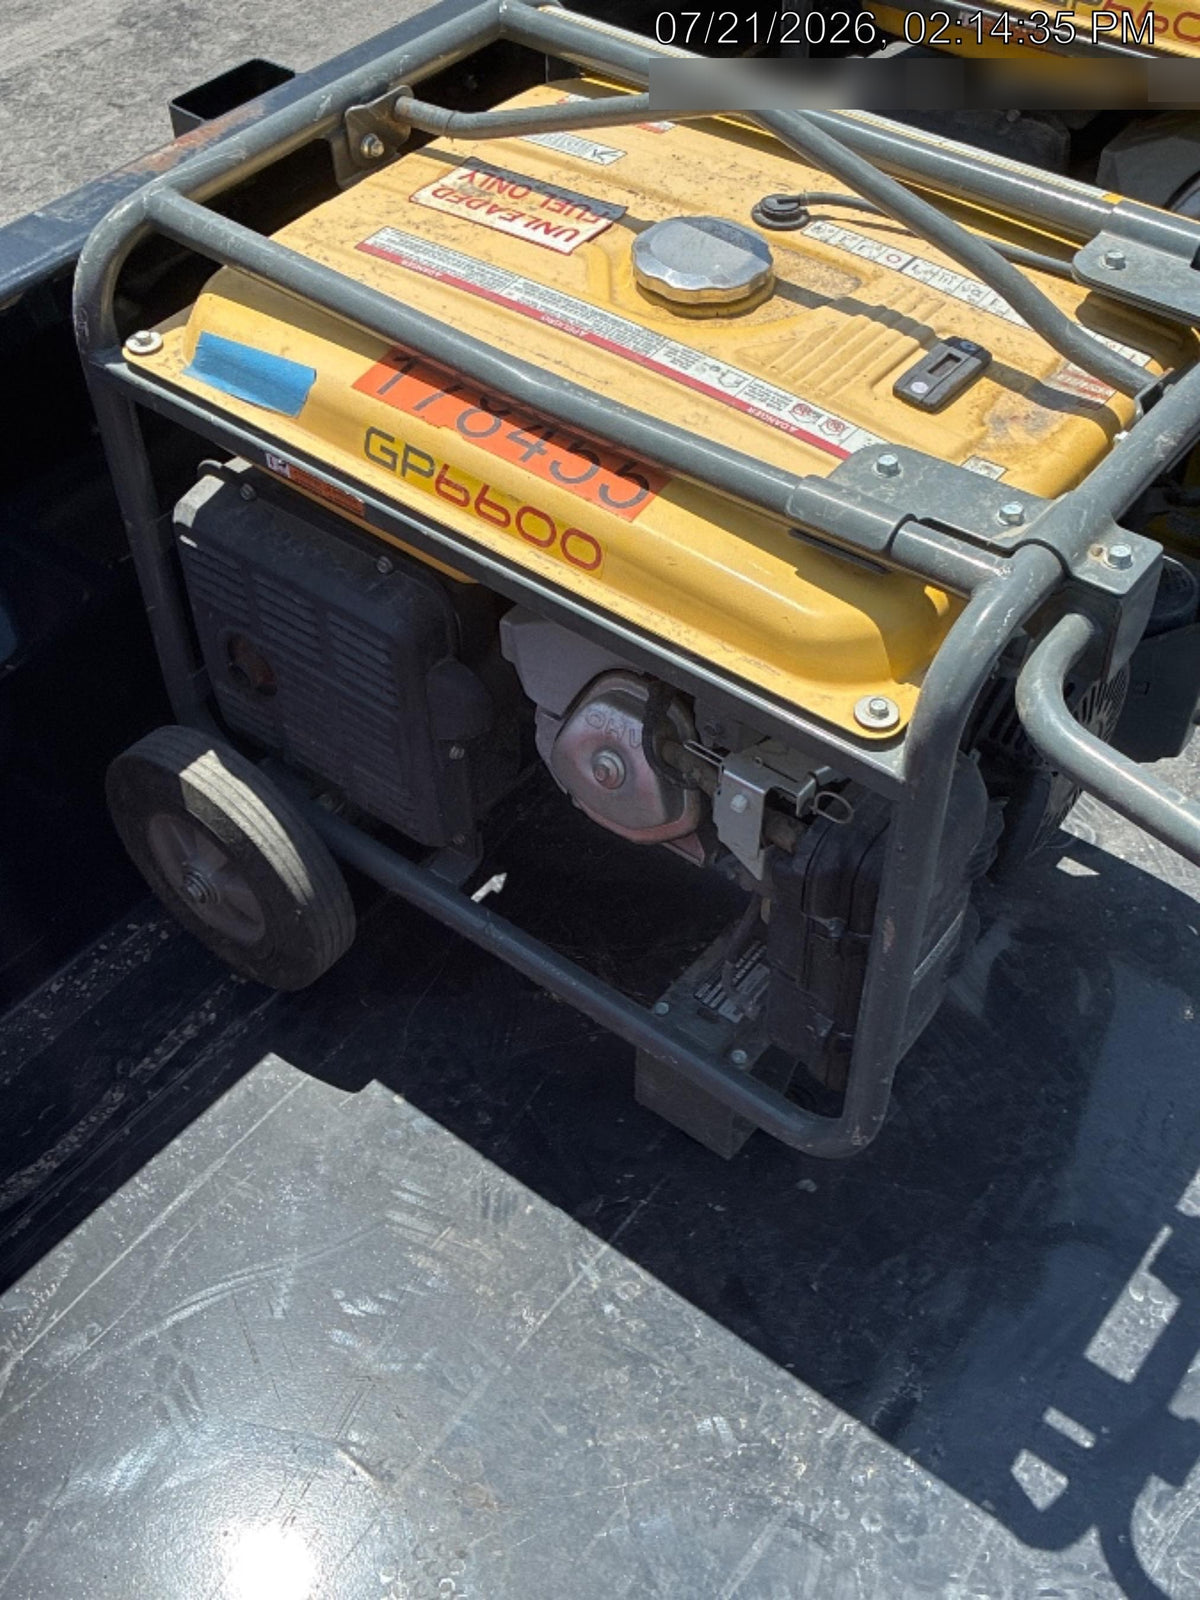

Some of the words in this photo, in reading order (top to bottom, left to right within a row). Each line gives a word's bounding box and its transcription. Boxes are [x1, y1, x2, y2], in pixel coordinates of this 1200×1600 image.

[459, 169, 532, 199] ONLY
[431, 184, 581, 243] UNLEADED
[539, 193, 609, 225] FUEL
[748, 406, 792, 431] DANGER
[363, 425, 603, 571] GP6600
